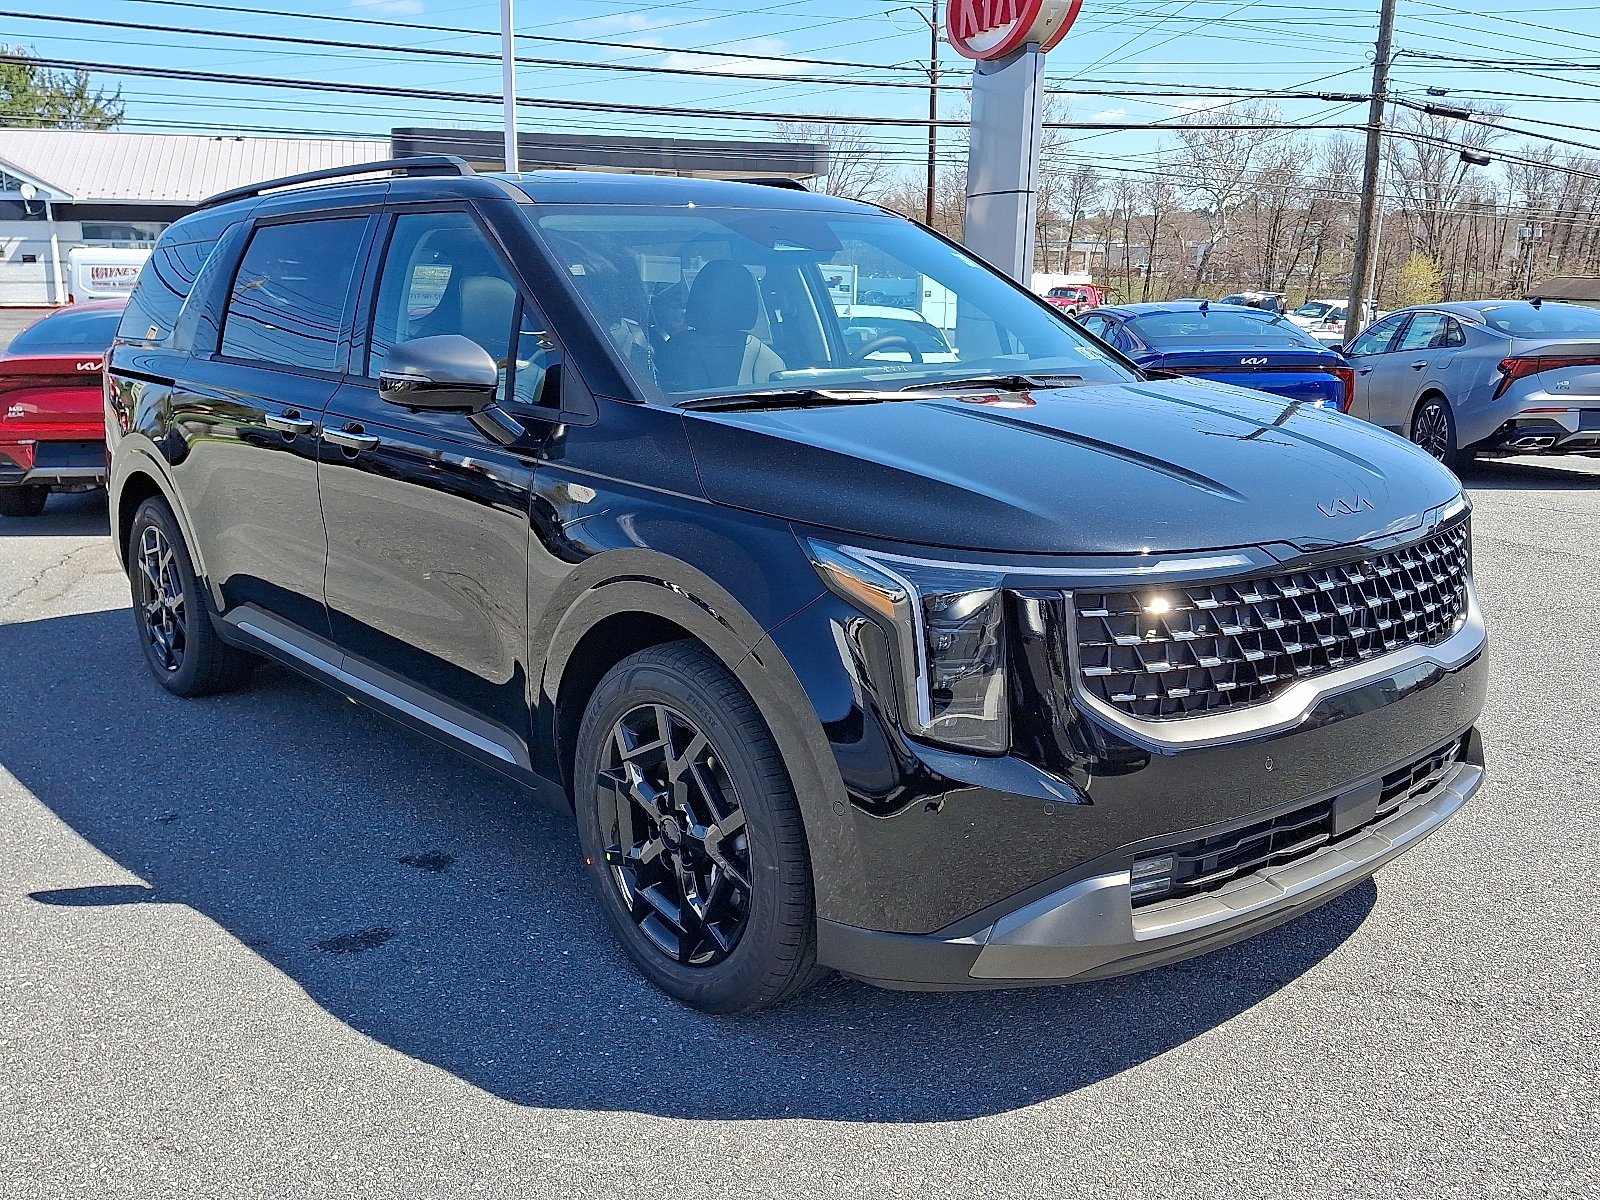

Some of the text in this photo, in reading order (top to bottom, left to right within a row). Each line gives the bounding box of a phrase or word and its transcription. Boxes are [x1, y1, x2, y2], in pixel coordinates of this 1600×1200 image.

[91, 267, 138, 280] WAYNE'S
[1240, 357, 1268, 365] KIA
[1316, 494, 1375, 518] KIA
